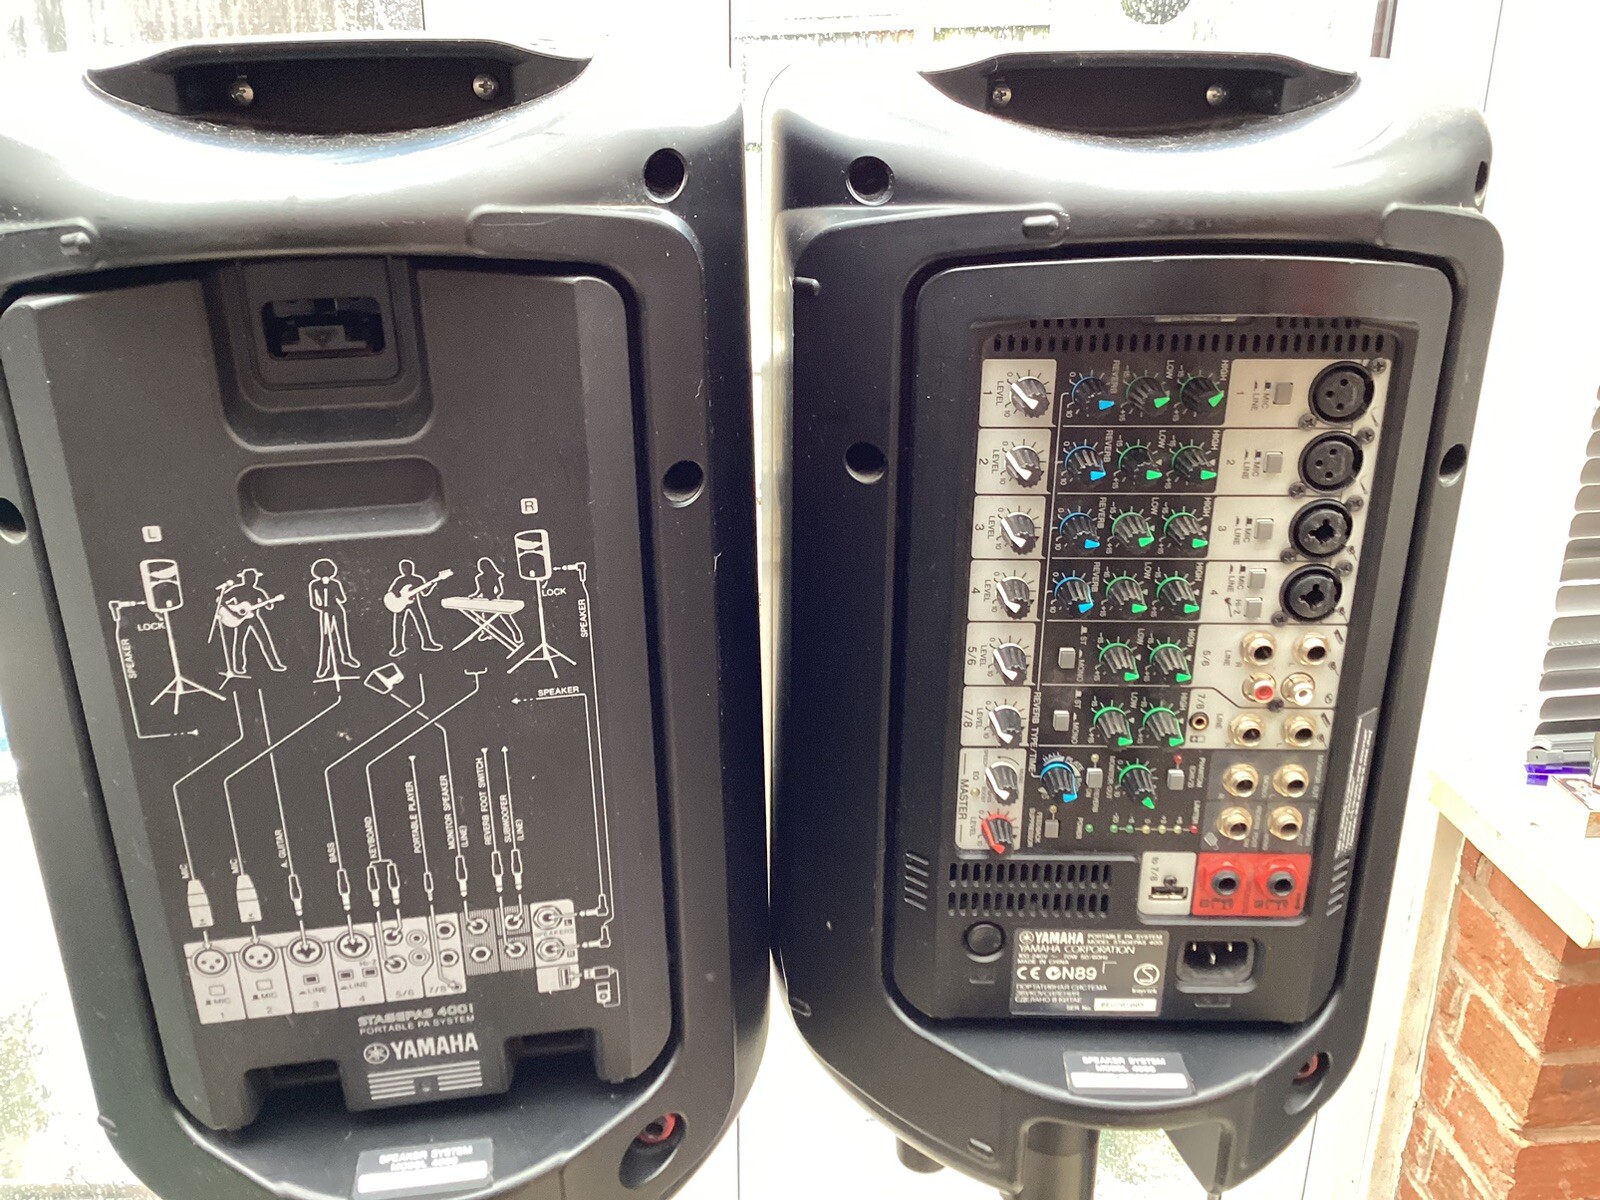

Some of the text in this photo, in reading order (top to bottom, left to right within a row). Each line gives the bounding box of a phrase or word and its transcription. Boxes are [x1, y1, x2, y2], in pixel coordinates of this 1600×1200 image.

[1110, 360, 1119, 394] REVERB
[1165, 360, 1174, 379] LOW
[1220, 360, 1228, 381] HIGH
[995, 381, 1004, 406] LEVEL
[1251, 393, 1260, 411] LINE
[1262, 393, 1270, 409] MIC
[1103, 430, 1112, 463] REVERB
[1157, 430, 1166, 448] LOW
[1211, 430, 1220, 450] HIGH
[991, 450, 999, 474] LEVEL
[1242, 462, 1250, 479] LINE
[1252, 461, 1260, 477] MIC
[1097, 497, 1106, 529] REVERB
[1151, 497, 1159, 515] LOW
[1202, 497, 1211, 517] HIGH
[987, 516, 995, 539] LEVEL
[1233, 528, 1241, 545] LINE
[1243, 528, 1251, 543] MIC
[1091, 562, 1100, 593] REVERB
[1144, 562, 1152, 579] LOW
[1194, 562, 1203, 581] HIGH
[541, 587, 567, 597] LOCK
[983, 580, 991, 602] LEVEL
[1227, 575, 1235, 592] LINE
[1237, 575, 1245, 590] MIC
[137, 621, 166, 632] LOCK
[578, 599, 588, 637] SPEAKER
[1079, 636, 1086, 645] ST
[1136, 628, 1145, 645] LOW
[1187, 629, 1195, 647] HIGH
[121, 638, 138, 680] SPEAKER
[967, 646, 977, 665] 5/6
[979, 645, 987, 667] LEVEL
[1076, 660, 1085, 682] MONO
[538, 686, 579, 697] SPEAKER
[1130, 692, 1138, 708] LOW
[1074, 699, 1081, 708] ST
[1179, 693, 1188, 710] HIGH
[1197, 694, 1205, 709] 7/8
[964, 710, 974, 728] 7/8
[975, 708, 983, 729] LEVEL
[1028, 692, 1042, 773] REVERB TYPE/TIME
[1071, 722, 1079, 744] MONO
[973, 771, 979, 780] EQ
[1196, 758, 1206, 788] PHANTOM
[475, 757, 492, 846] REVERB FOOT SWITCH
[959, 779, 969, 820] MASTER
[404, 781, 422, 854] PORTABLE PLAYER
[440, 774, 455, 850] MONITOR SPEAKER
[499, 794, 512, 843] SUBWOOFER
[1192, 800, 1200, 824] LIMITER
[1034, 812, 1042, 843] FEEDBACK
[274, 829, 287, 859] GUITAR
[364, 816, 378, 859] KEYBOARD
[326, 842, 337, 863] BASS
[179, 863, 189, 879] MIC
[229, 858, 239, 874] MIC
[1150, 857, 1159, 881] to 7/8
[1035, 931, 1084, 945] YAMAHA
[1018, 944, 1136, 955] YAMAHA CORPORATION
[307, 986, 327, 995] LINE
[347, 981, 368, 990] LINE
[395, 988, 415, 997] 5/6
[213, 996, 230, 1005] MIC
[261, 991, 278, 1000] MIC
[359, 1014, 475, 1035] PORTABLE PA SYSTEM
[390, 1032, 479, 1060] YAMAHA
